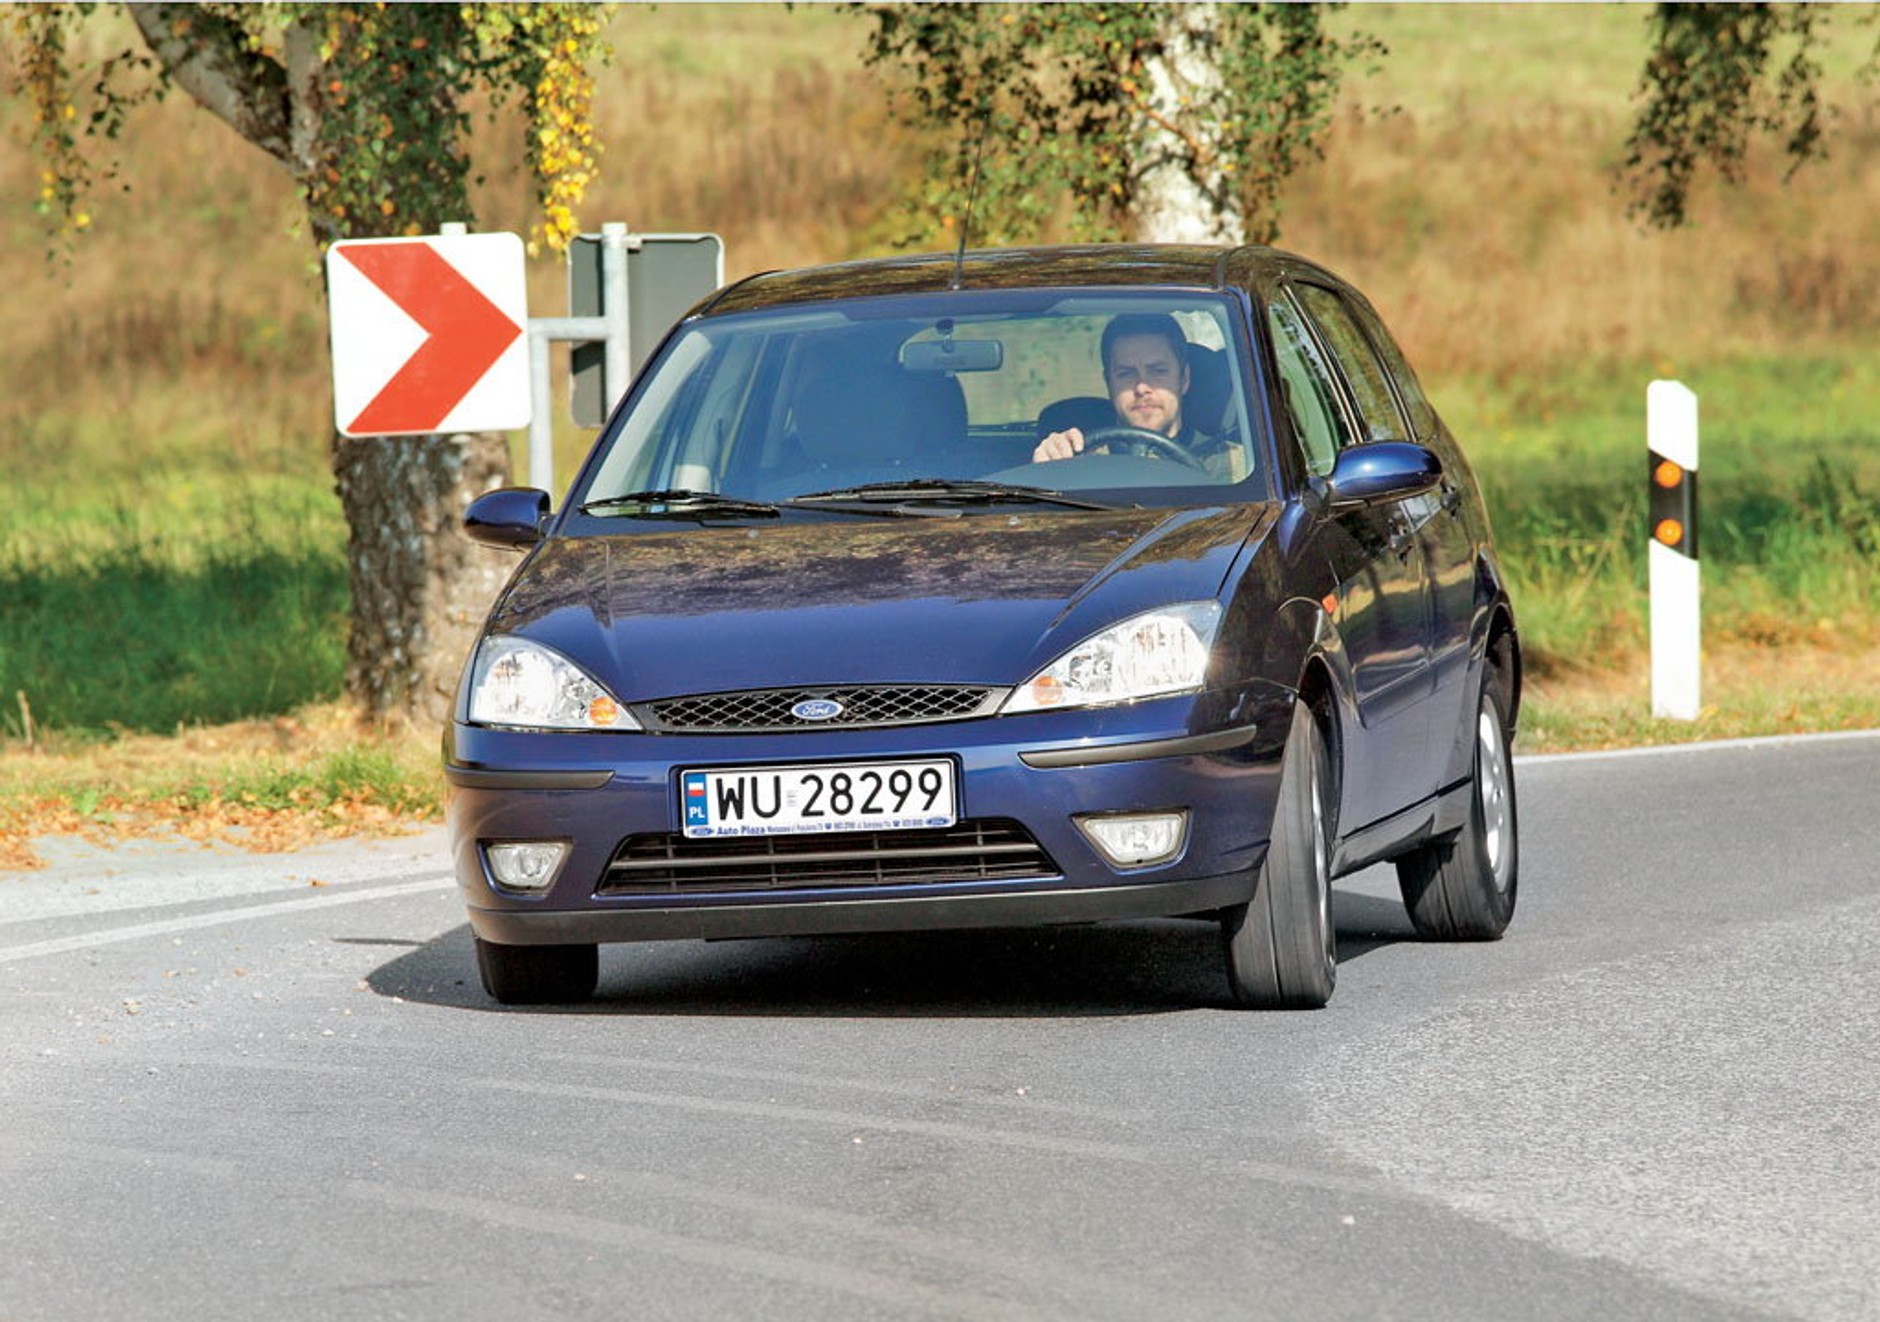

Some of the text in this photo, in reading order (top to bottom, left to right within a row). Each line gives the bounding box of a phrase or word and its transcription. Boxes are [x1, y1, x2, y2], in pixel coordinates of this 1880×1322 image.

[802, 702, 832, 716] Ford
[715, 768, 943, 820] WU 28299
[689, 806, 706, 819] PL
[716, 826, 739, 836] Auto
